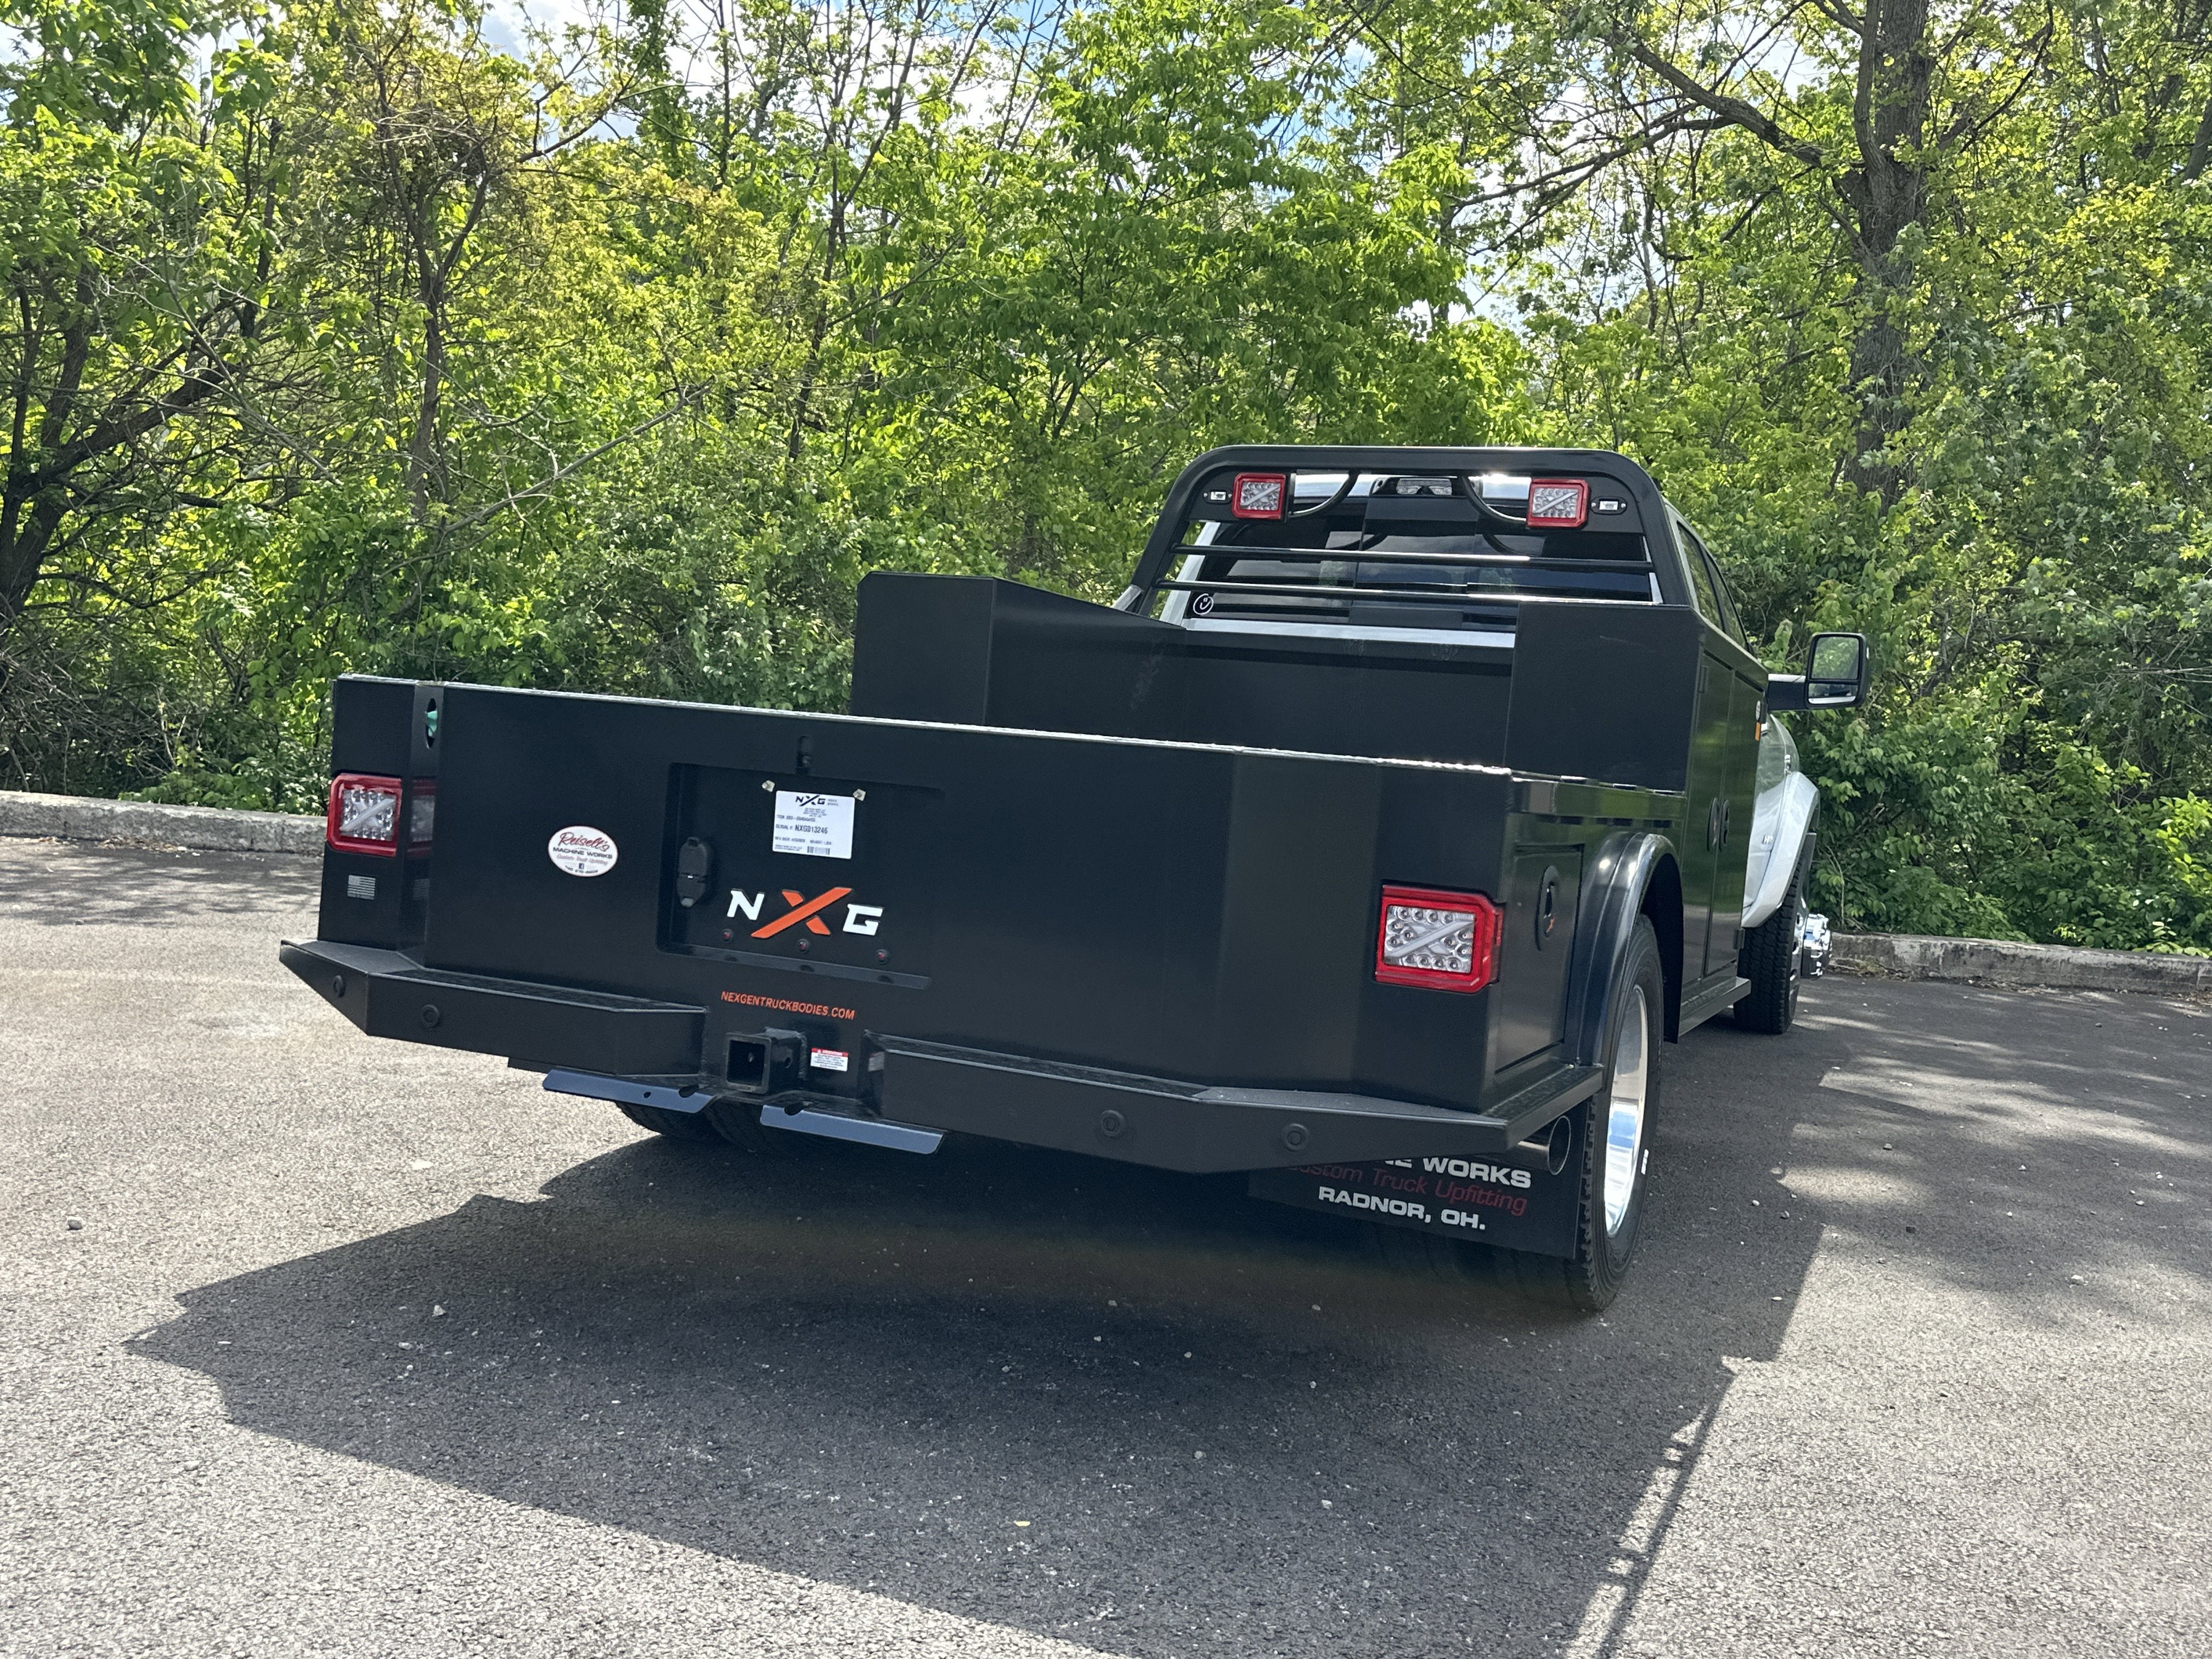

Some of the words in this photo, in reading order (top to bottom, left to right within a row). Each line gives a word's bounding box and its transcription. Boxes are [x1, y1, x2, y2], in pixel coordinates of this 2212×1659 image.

[795, 795, 826, 806] NXG
[553, 847, 584, 855] MACHINE
[721, 991, 856, 1020] NEXGENTRUCKBODIES.COM
[1423, 1157, 1532, 1188] WORKS
[1288, 1164, 1364, 1183] ustom
[1372, 1167, 1426, 1194] Truck
[1435, 1180, 1528, 1217] Upfitting
[1318, 1186, 1431, 1223] RADNOR,
[1441, 1209, 1486, 1230] OH.
